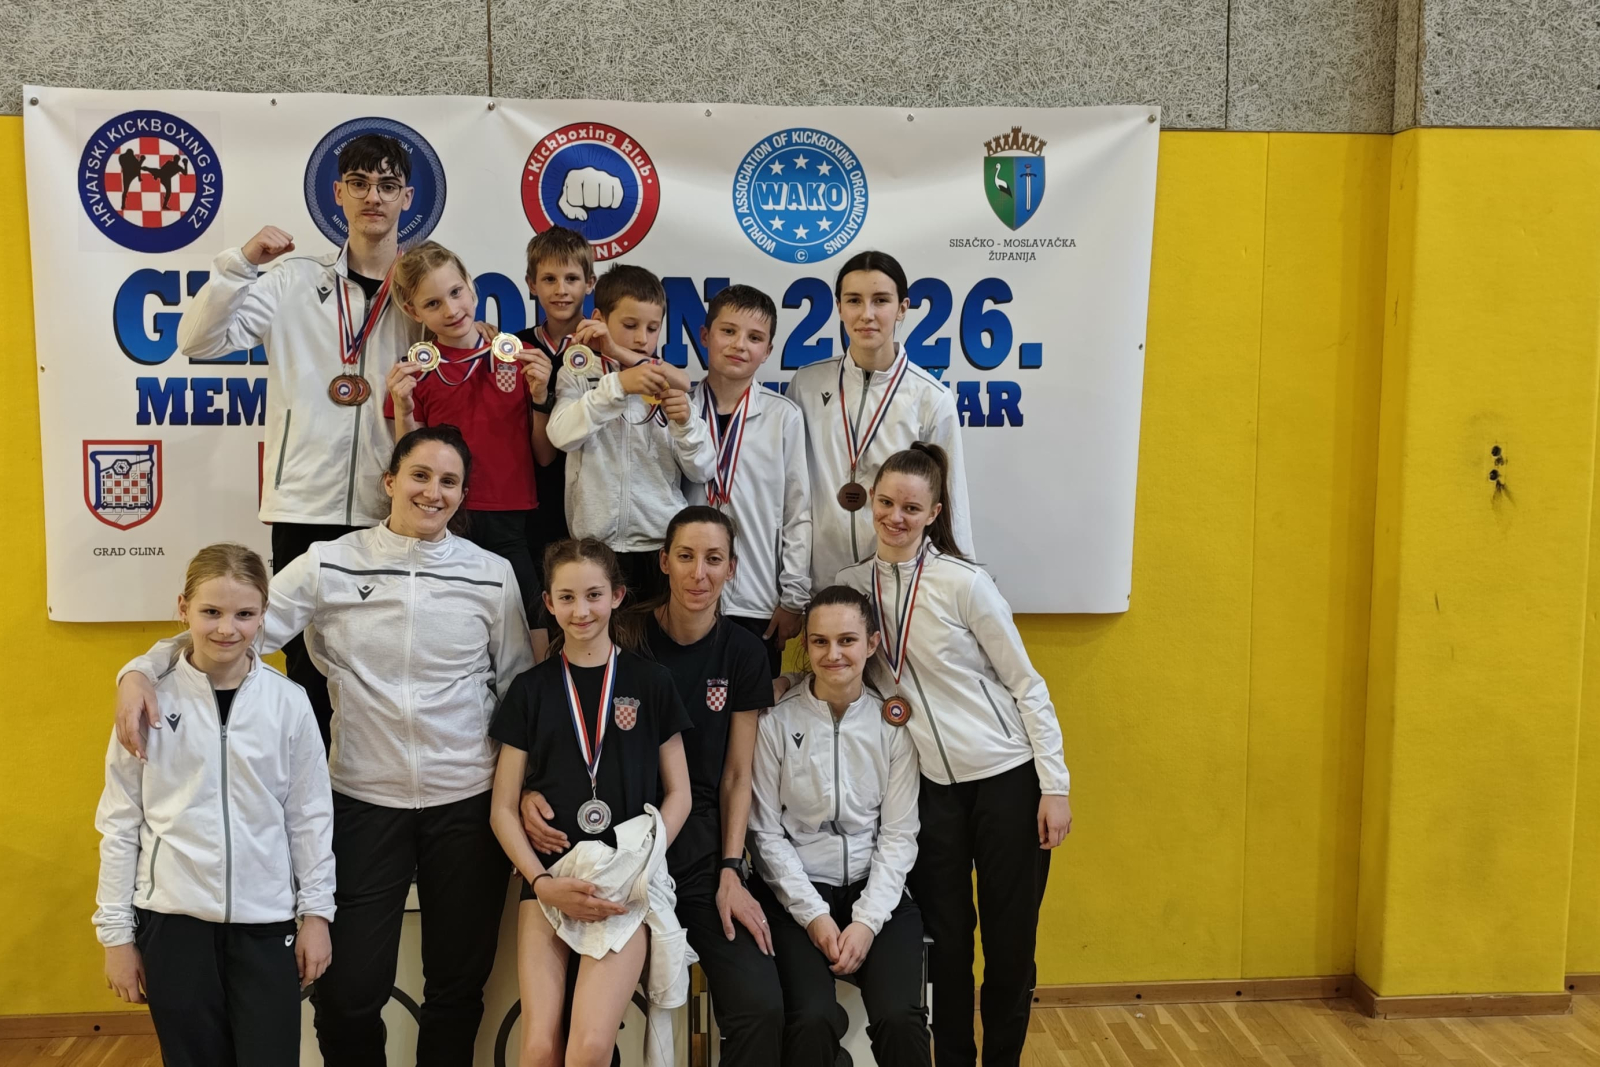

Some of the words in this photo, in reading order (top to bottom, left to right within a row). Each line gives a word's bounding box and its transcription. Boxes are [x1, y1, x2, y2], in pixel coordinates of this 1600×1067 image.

[528, 126, 616, 173] Kickboxing
[621, 138, 653, 176] klub
[772, 133, 788, 148] OF
[792, 131, 856, 170] KICKBOXING
[86, 140, 115, 227] HRVATSKI
[107, 118, 210, 167] KICKBOXING
[188, 173, 215, 229] SAVEZ
[735, 141, 772, 213] ASSOCIATION
[755, 182, 848, 211] WAKO
[823, 170, 865, 254] ORGANIZATIONS
[742, 216, 776, 253] WORLD
[949, 237, 995, 248] SISAČKO
[1003, 237, 1077, 248] MOSLAVAČKA
[988, 251, 1037, 262] ŽUPANIJA
[781, 277, 1043, 370] 226.
[93, 547, 126, 556] GRAD
[129, 547, 165, 556] GLINA
